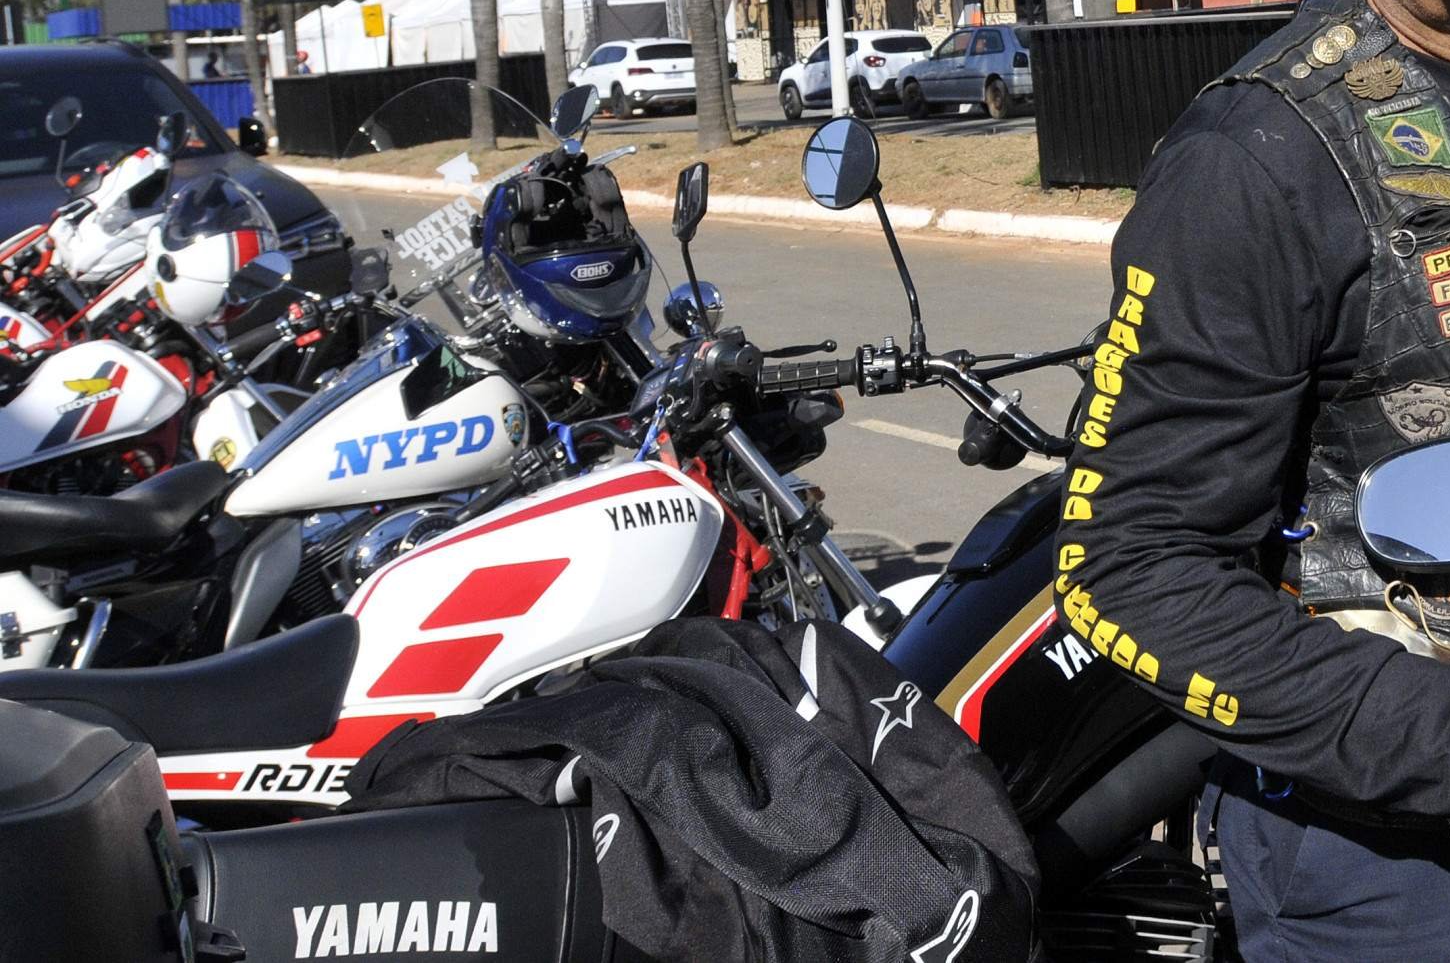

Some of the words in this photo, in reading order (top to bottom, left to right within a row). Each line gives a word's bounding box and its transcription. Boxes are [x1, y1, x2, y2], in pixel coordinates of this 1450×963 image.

[57, 386, 124, 414] HONDA
[328, 415, 495, 480] NYPD
[605, 498, 698, 531] YAMAHA
[1063, 468, 1103, 521] DO
[1184, 672, 1239, 726] MC
[293, 901, 499, 959] YAMAHA
